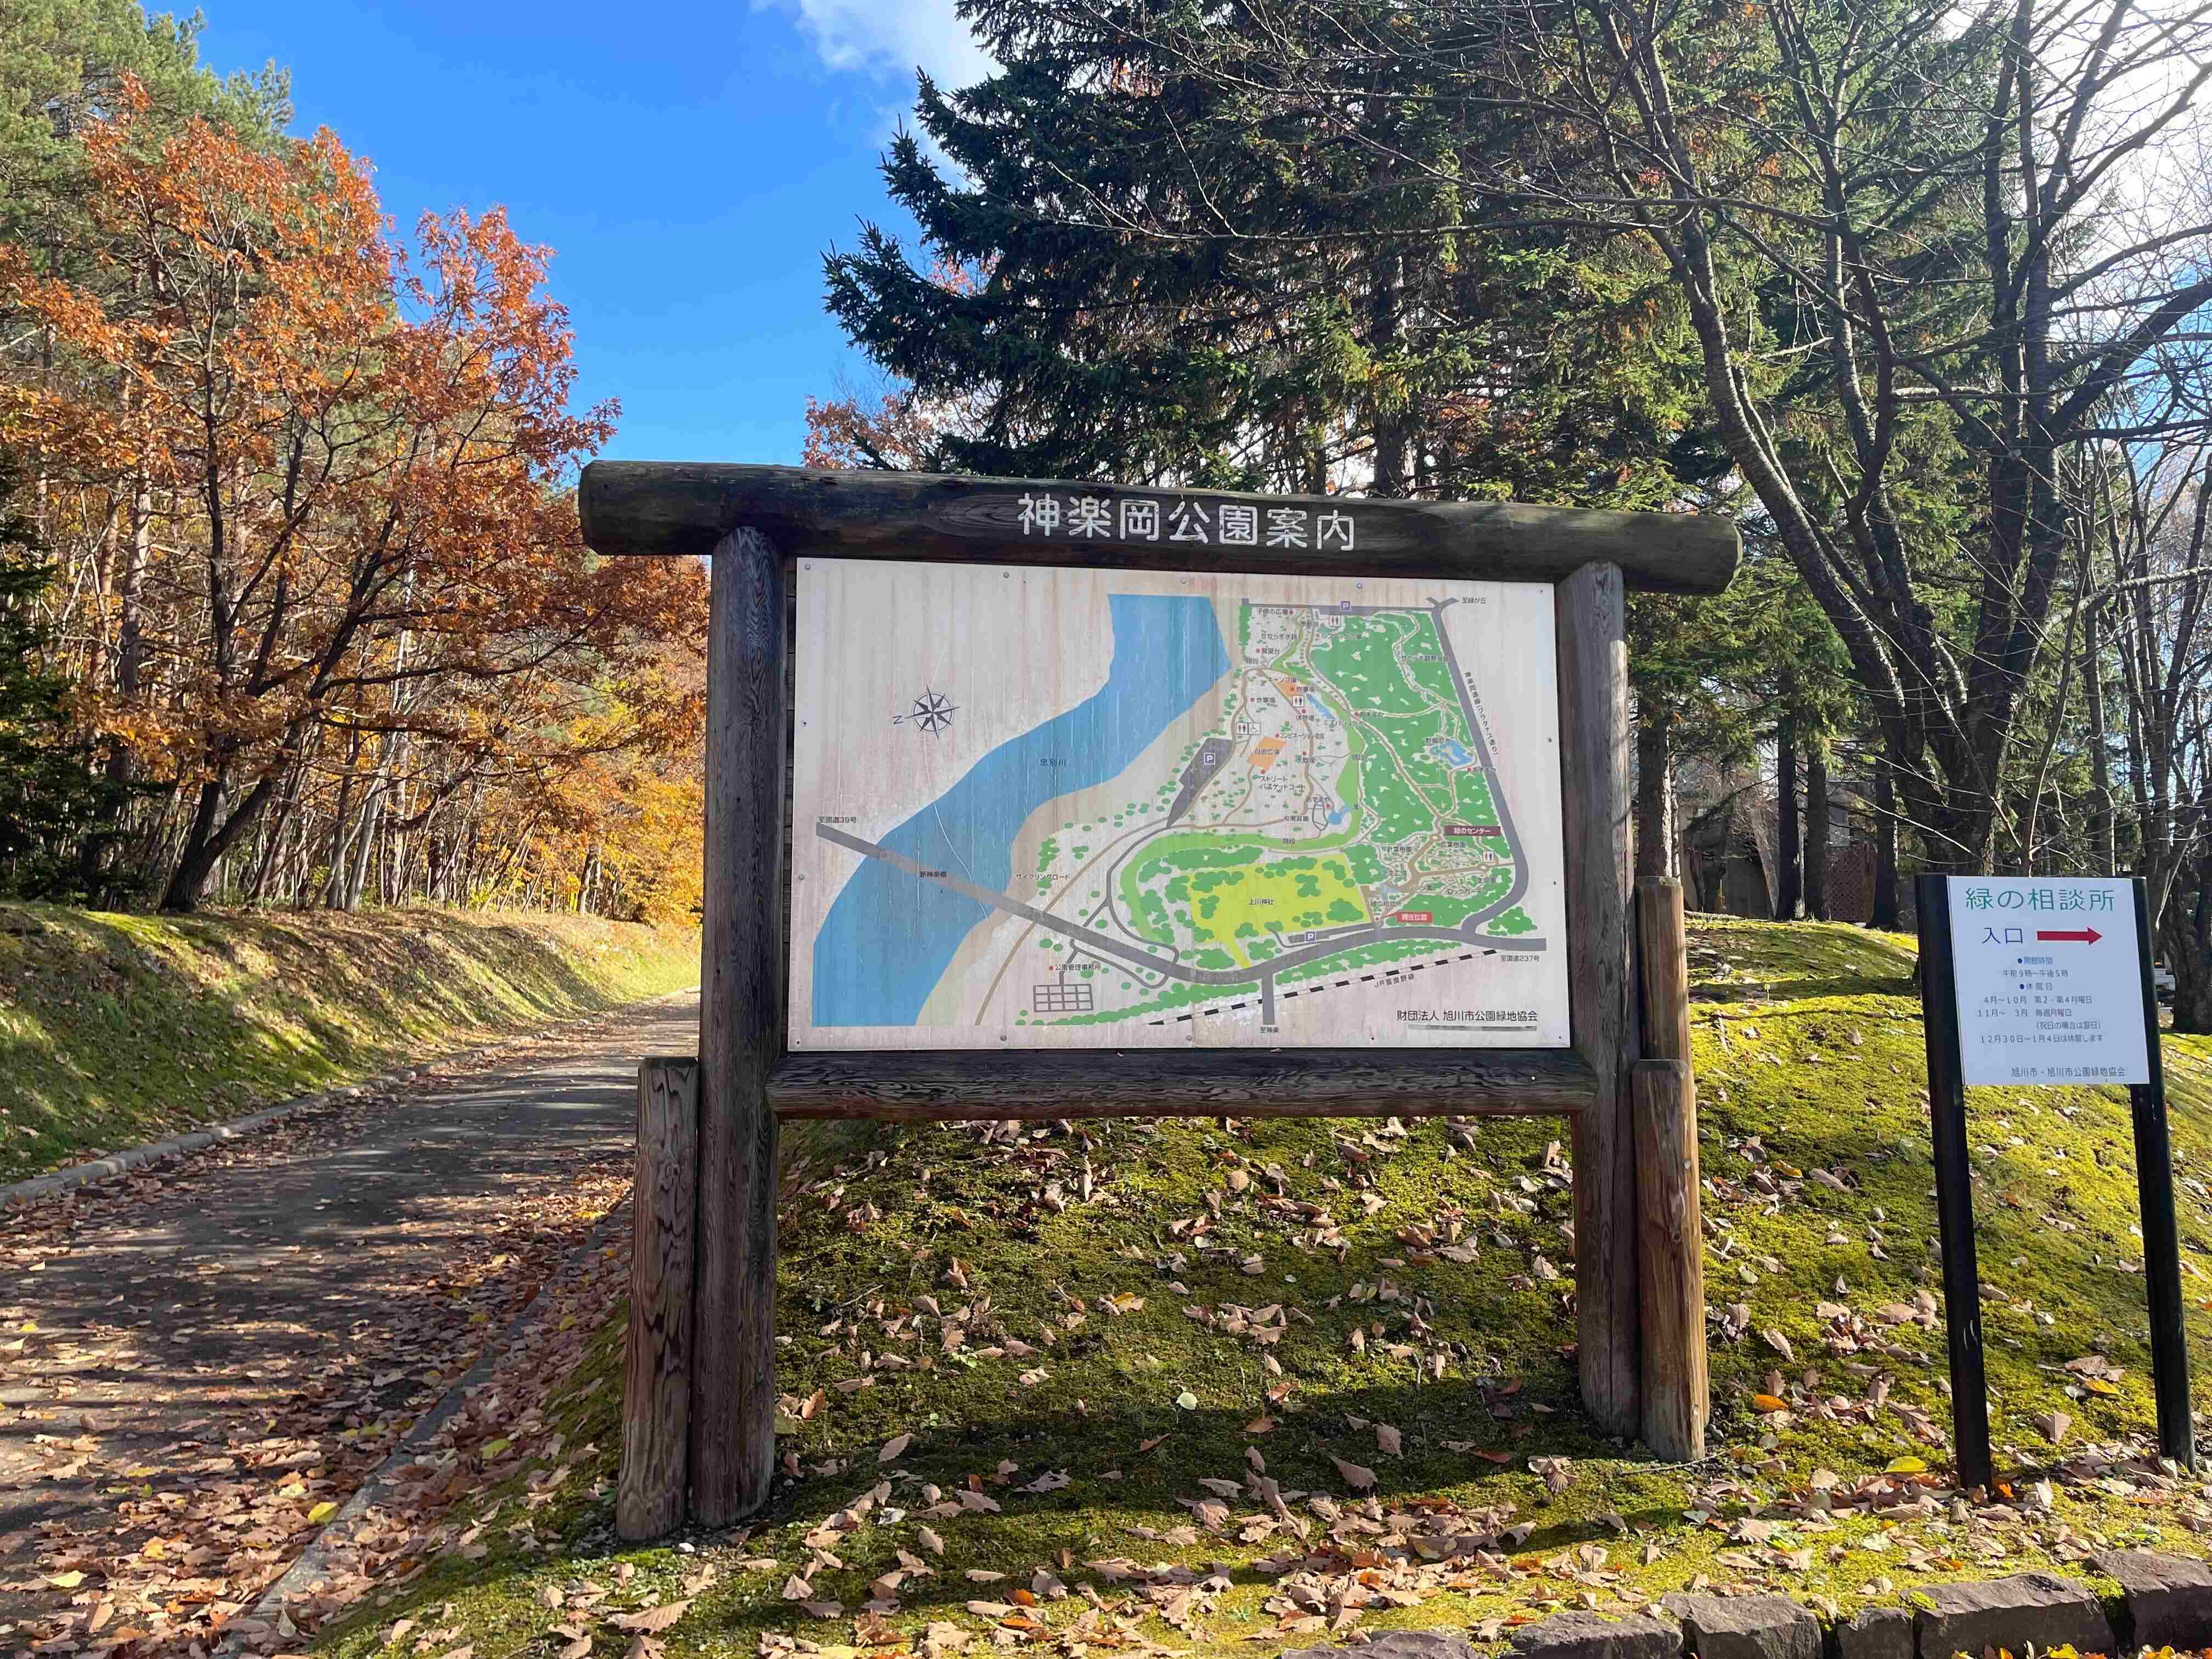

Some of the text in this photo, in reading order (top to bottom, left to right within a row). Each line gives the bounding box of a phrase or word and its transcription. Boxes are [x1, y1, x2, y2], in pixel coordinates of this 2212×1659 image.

[1017, 492, 1355, 551] 神楽岡公園案内
[892, 715, 904, 725] N
[1040, 758, 1068, 767] 忠別川
[1453, 826, 1492, 835] 緑のセンター
[1966, 887, 2116, 912] 緑の相談所
[1982, 927, 2024, 944] 入口
[1374, 973, 1415, 988] JR富良野線
[1397, 1010, 1538, 1022] 財団法人 旭川市公園緑地協会
[2011, 1067, 2125, 1077] 旭川市・旭川市公園緑地協会
